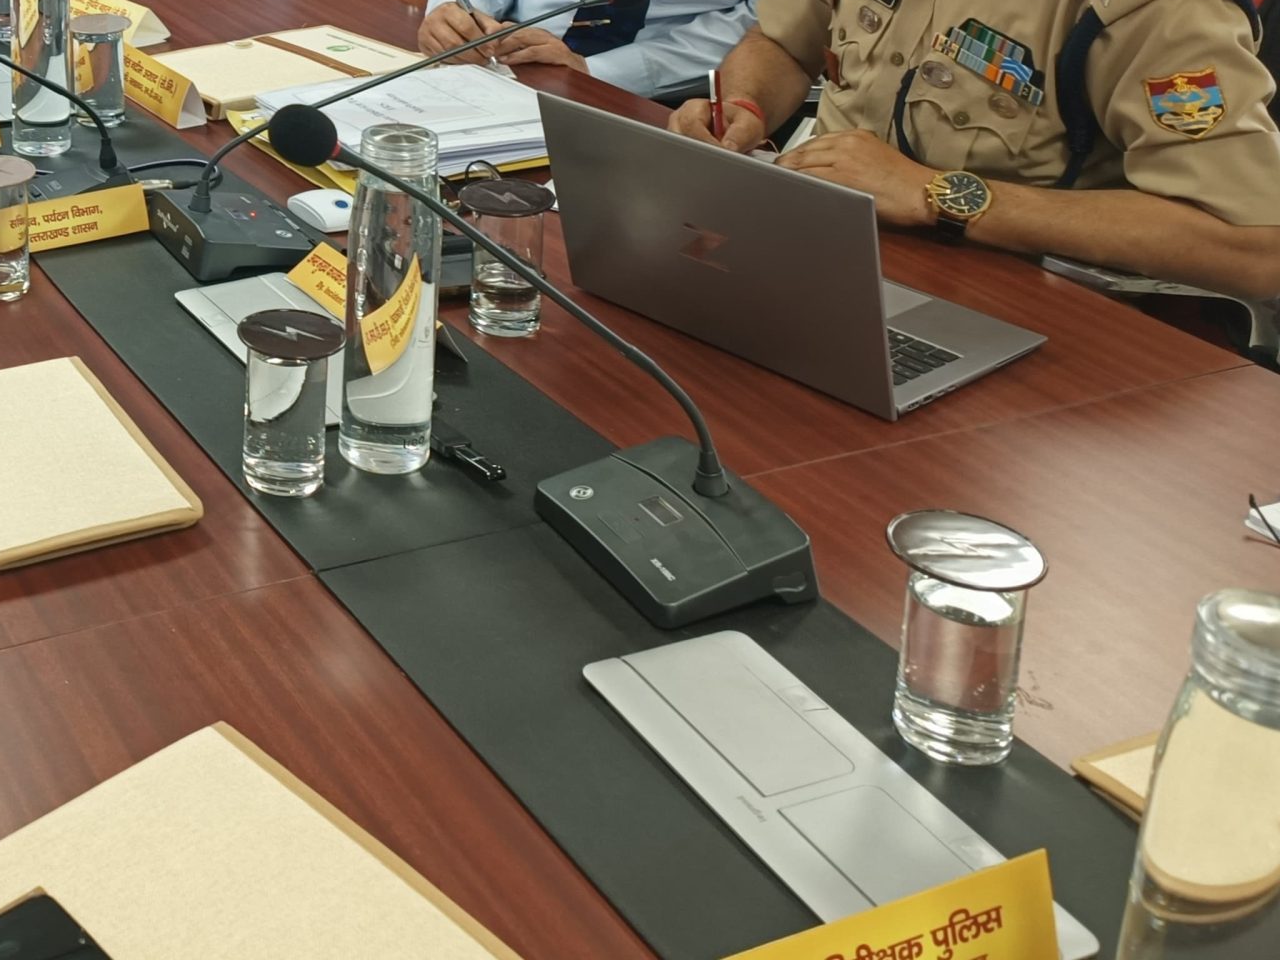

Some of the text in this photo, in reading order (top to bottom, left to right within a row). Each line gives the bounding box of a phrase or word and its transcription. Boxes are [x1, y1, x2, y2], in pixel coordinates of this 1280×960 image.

[42, 209, 70, 224] पर्यटन
[71, 204, 104, 218] विभाग,
[71, 221, 99, 235] शासन
[930, 905, 1003, 960] पुलिस
